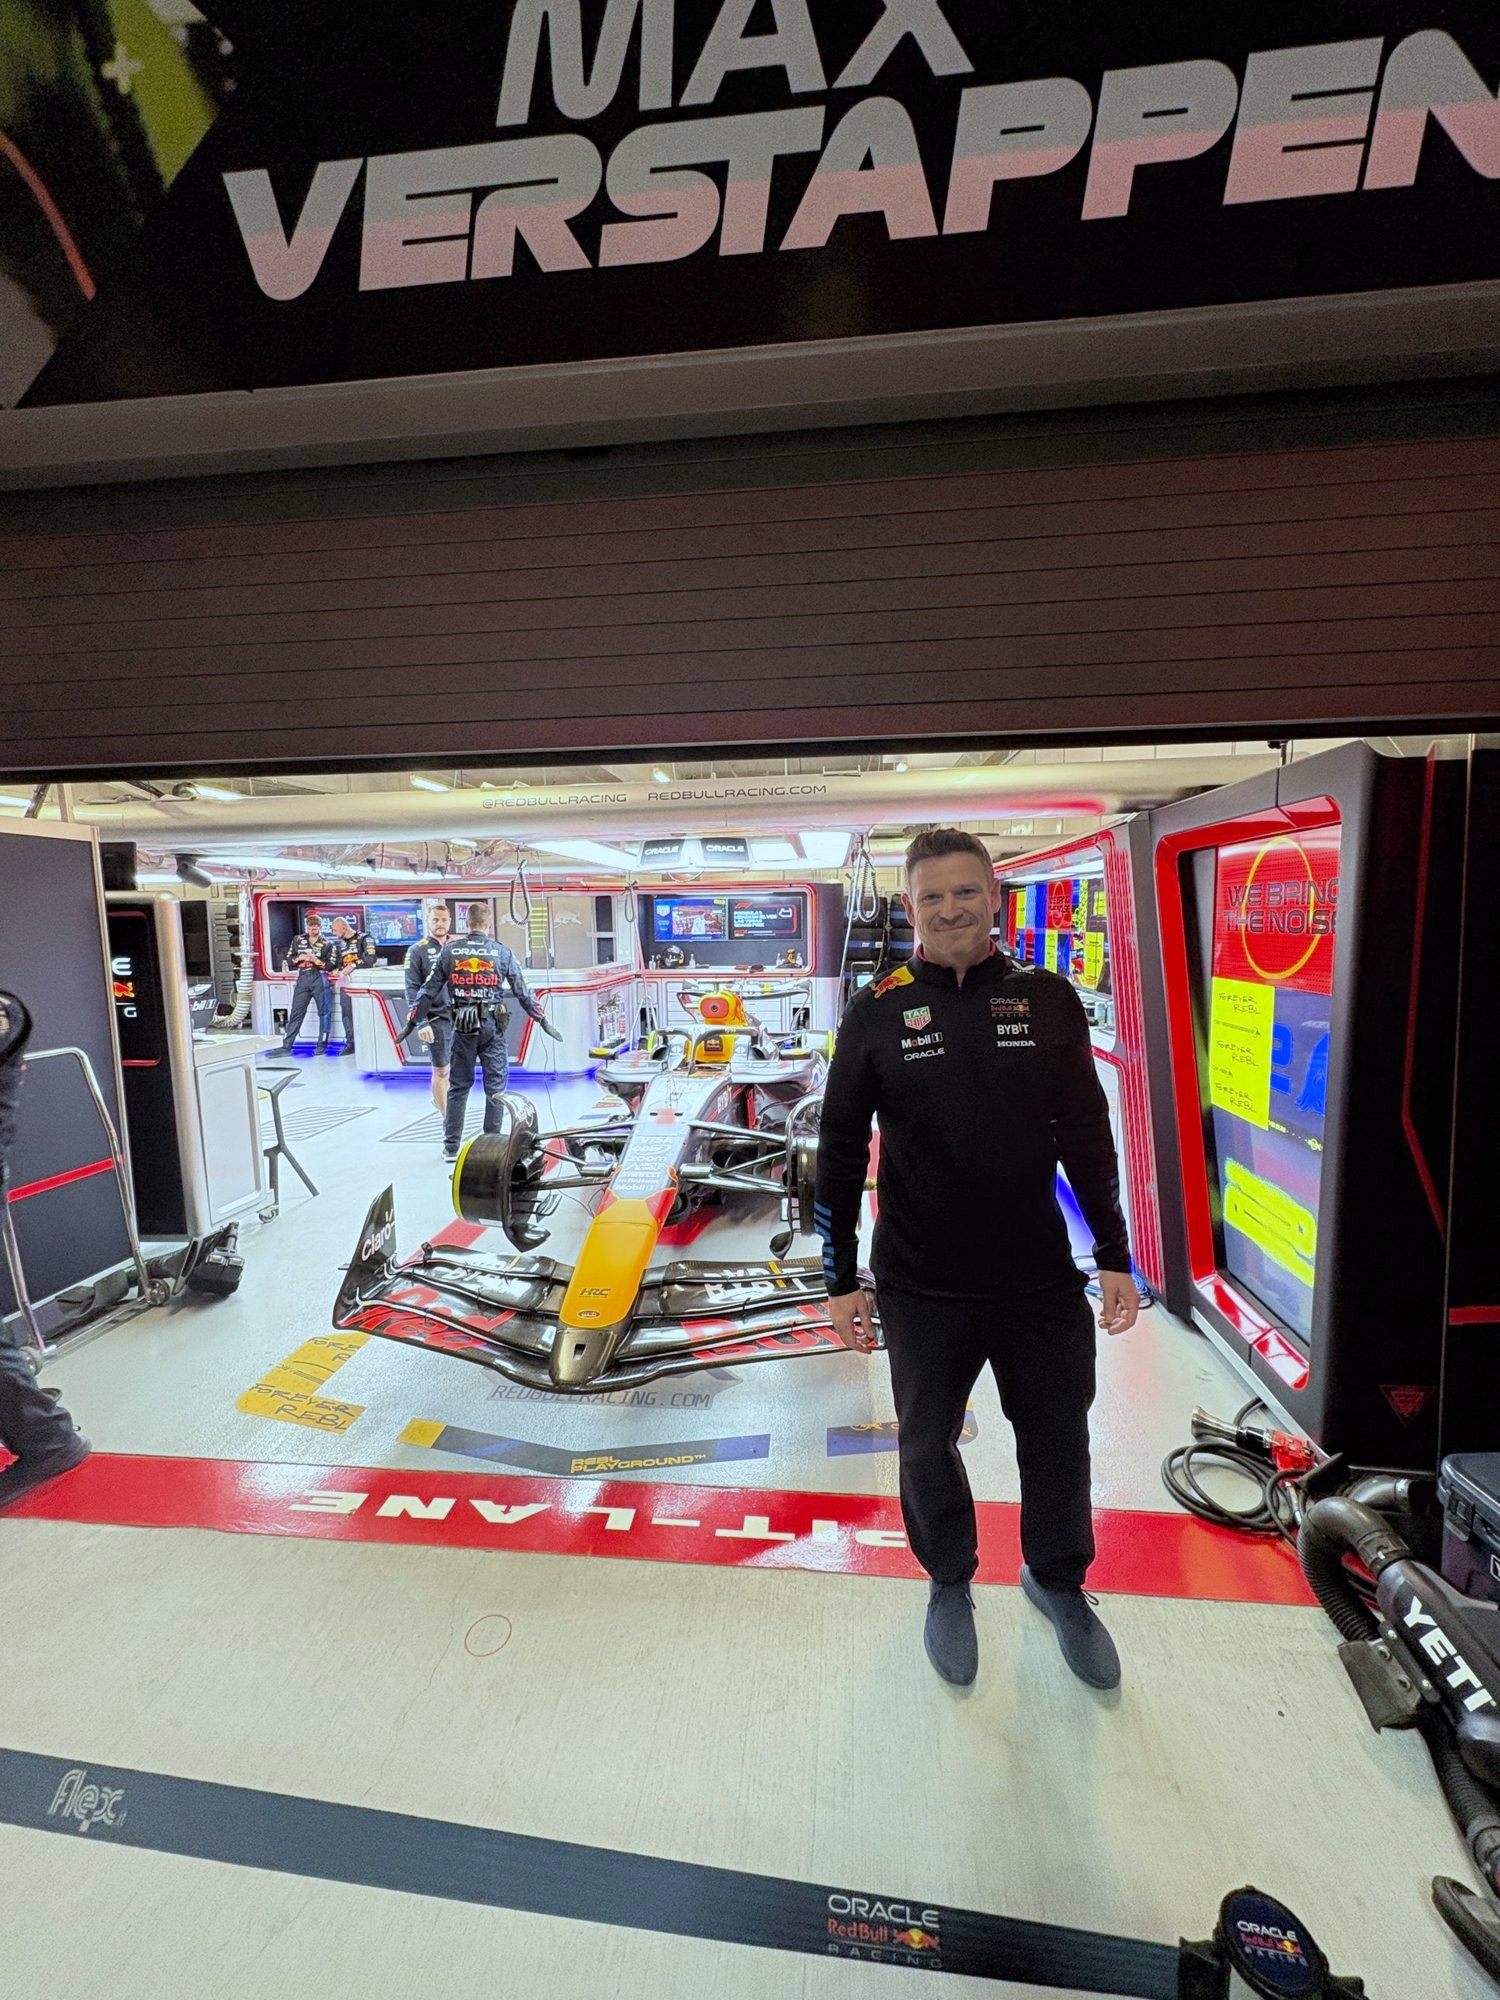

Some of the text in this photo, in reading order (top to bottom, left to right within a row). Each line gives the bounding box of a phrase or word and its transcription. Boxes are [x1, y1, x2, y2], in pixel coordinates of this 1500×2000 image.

[496, 0, 975, 128] MAX
[223, 28, 1500, 301] VERSTAPPEN
[482, 785, 827, 809] @REDBULLRACING REDBULLRACING.COM
[644, 845, 680, 857] ORACLE
[705, 843, 745, 854] ORACLE
[1228, 883, 1262, 907] WE
[1224, 910, 1264, 933] THE
[451, 948, 499, 957] ORACLE
[451, 973, 498, 986] Red Bull
[990, 997, 1029, 1005] ORACLE
[907, 1008, 928, 1019] TAG
[996, 1022, 1029, 1035] BYBIT
[901, 1034, 931, 1050] Mobil
[903, 1047, 945, 1061] ORACLE
[996, 1040, 1037, 1048] HONDA
[361, 1227, 393, 1262] Claro
[680, 1301, 860, 1363] Bul
[249, 1383, 355, 1418] FOREVER
[275, 1403, 349, 1431] REBL
[1403, 1595, 1493, 1712] YETI
[48, 1769, 125, 1826] flex
[828, 1894, 940, 1928] ORACLE
[828, 1917, 888, 1942] Red Bull
[1237, 1920, 1297, 1942] ORACLE
[828, 1943, 943, 1969] RACING
